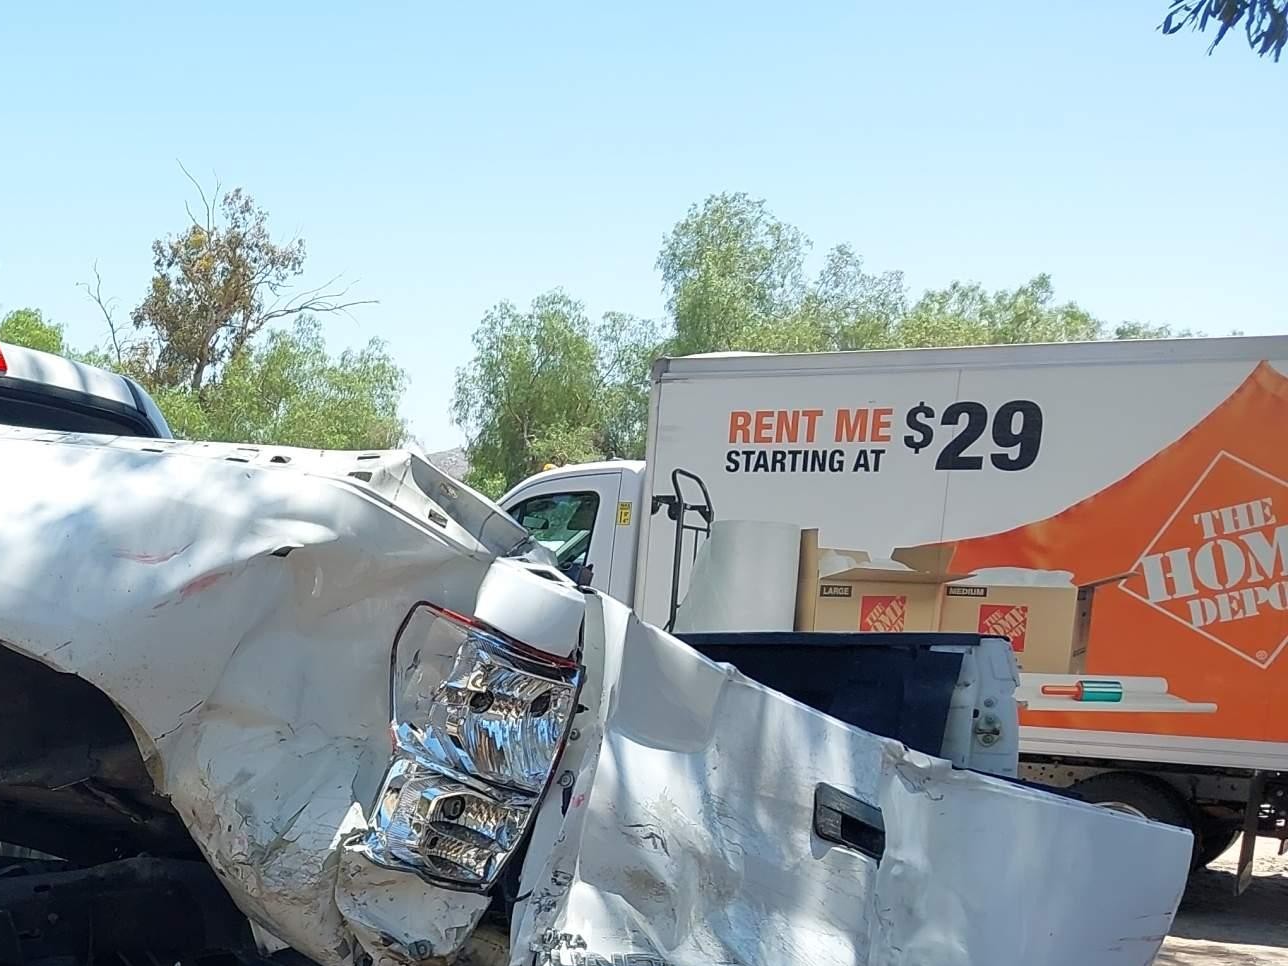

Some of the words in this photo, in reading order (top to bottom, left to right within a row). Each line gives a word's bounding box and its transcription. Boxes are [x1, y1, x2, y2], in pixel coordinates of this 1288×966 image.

[728, 410, 824, 443] RENT
[834, 407, 894, 442] ME
[903, 400, 1044, 472] $29
[725, 449, 845, 473] STARTING
[853, 448, 886, 472] AT
[1193, 498, 1277, 539] THE
[1141, 525, 1288, 603] HOM
[822, 586, 850, 596] LARGE
[948, 586, 985, 596] MEDIUM
[1187, 581, 1288, 628] DEPO
